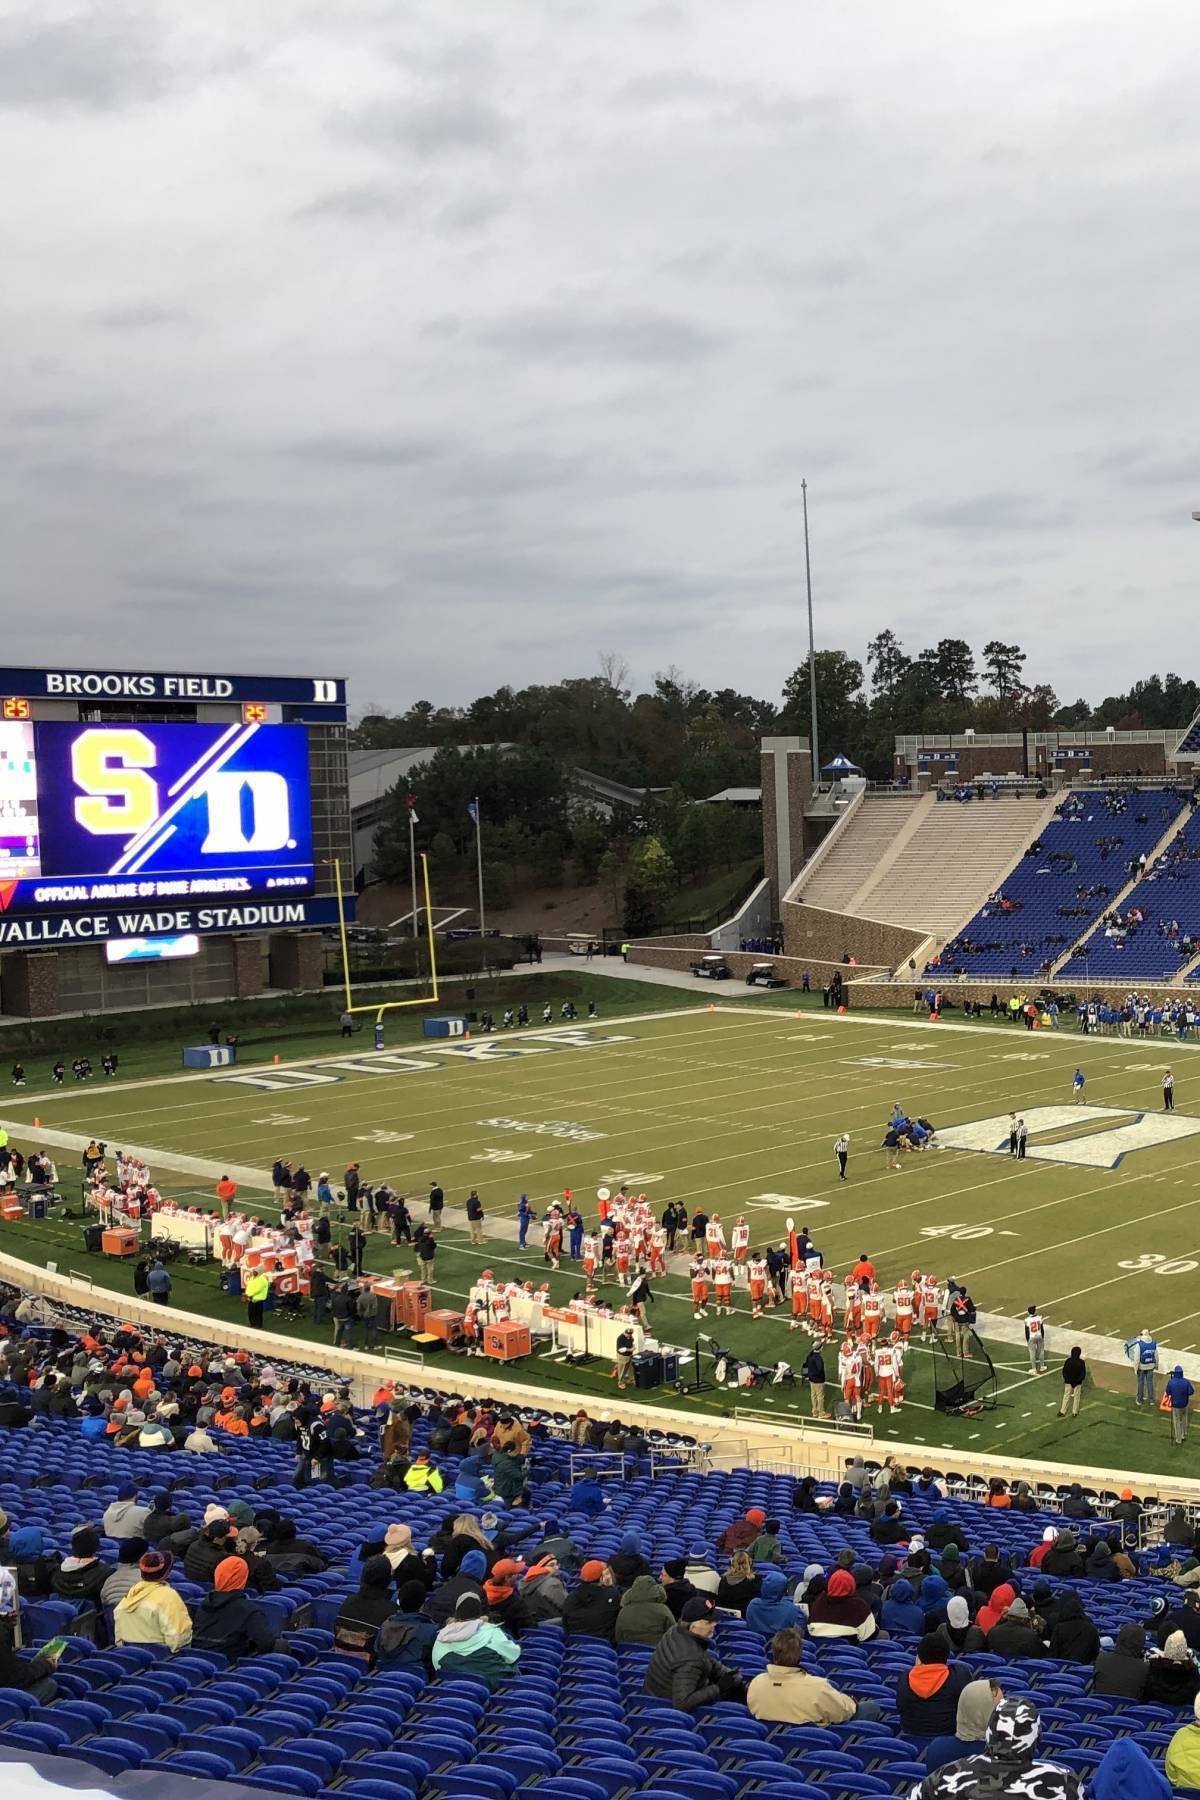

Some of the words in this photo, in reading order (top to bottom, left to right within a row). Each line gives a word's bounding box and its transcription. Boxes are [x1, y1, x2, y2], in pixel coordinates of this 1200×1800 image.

[45, 673, 156, 696] BROOKS
[162, 677, 234, 698] FIELD
[312, 680, 338, 702] D
[4, 699, 28, 718] 25
[244, 704, 267, 722] 25
[71, 728, 159, 835] S
[200, 771, 290, 854] D
[34, 885, 89, 903] OFFICIAL
[0, 917, 110, 943] ALLACE
[117, 911, 192, 934] WADE
[197, 904, 306, 929] STADIUM
[208, 1030, 640, 1091] DUKE
[352, 1129, 415, 1143] 20
[469, 1147, 534, 1163] 30
[598, 1168, 665, 1185] 40
[919, 1223, 995, 1240] 40
[1116, 1253, 1199, 1275] 30
[281, 1278, 293, 1291] G
[1030, 1321, 1042, 1332] 21
